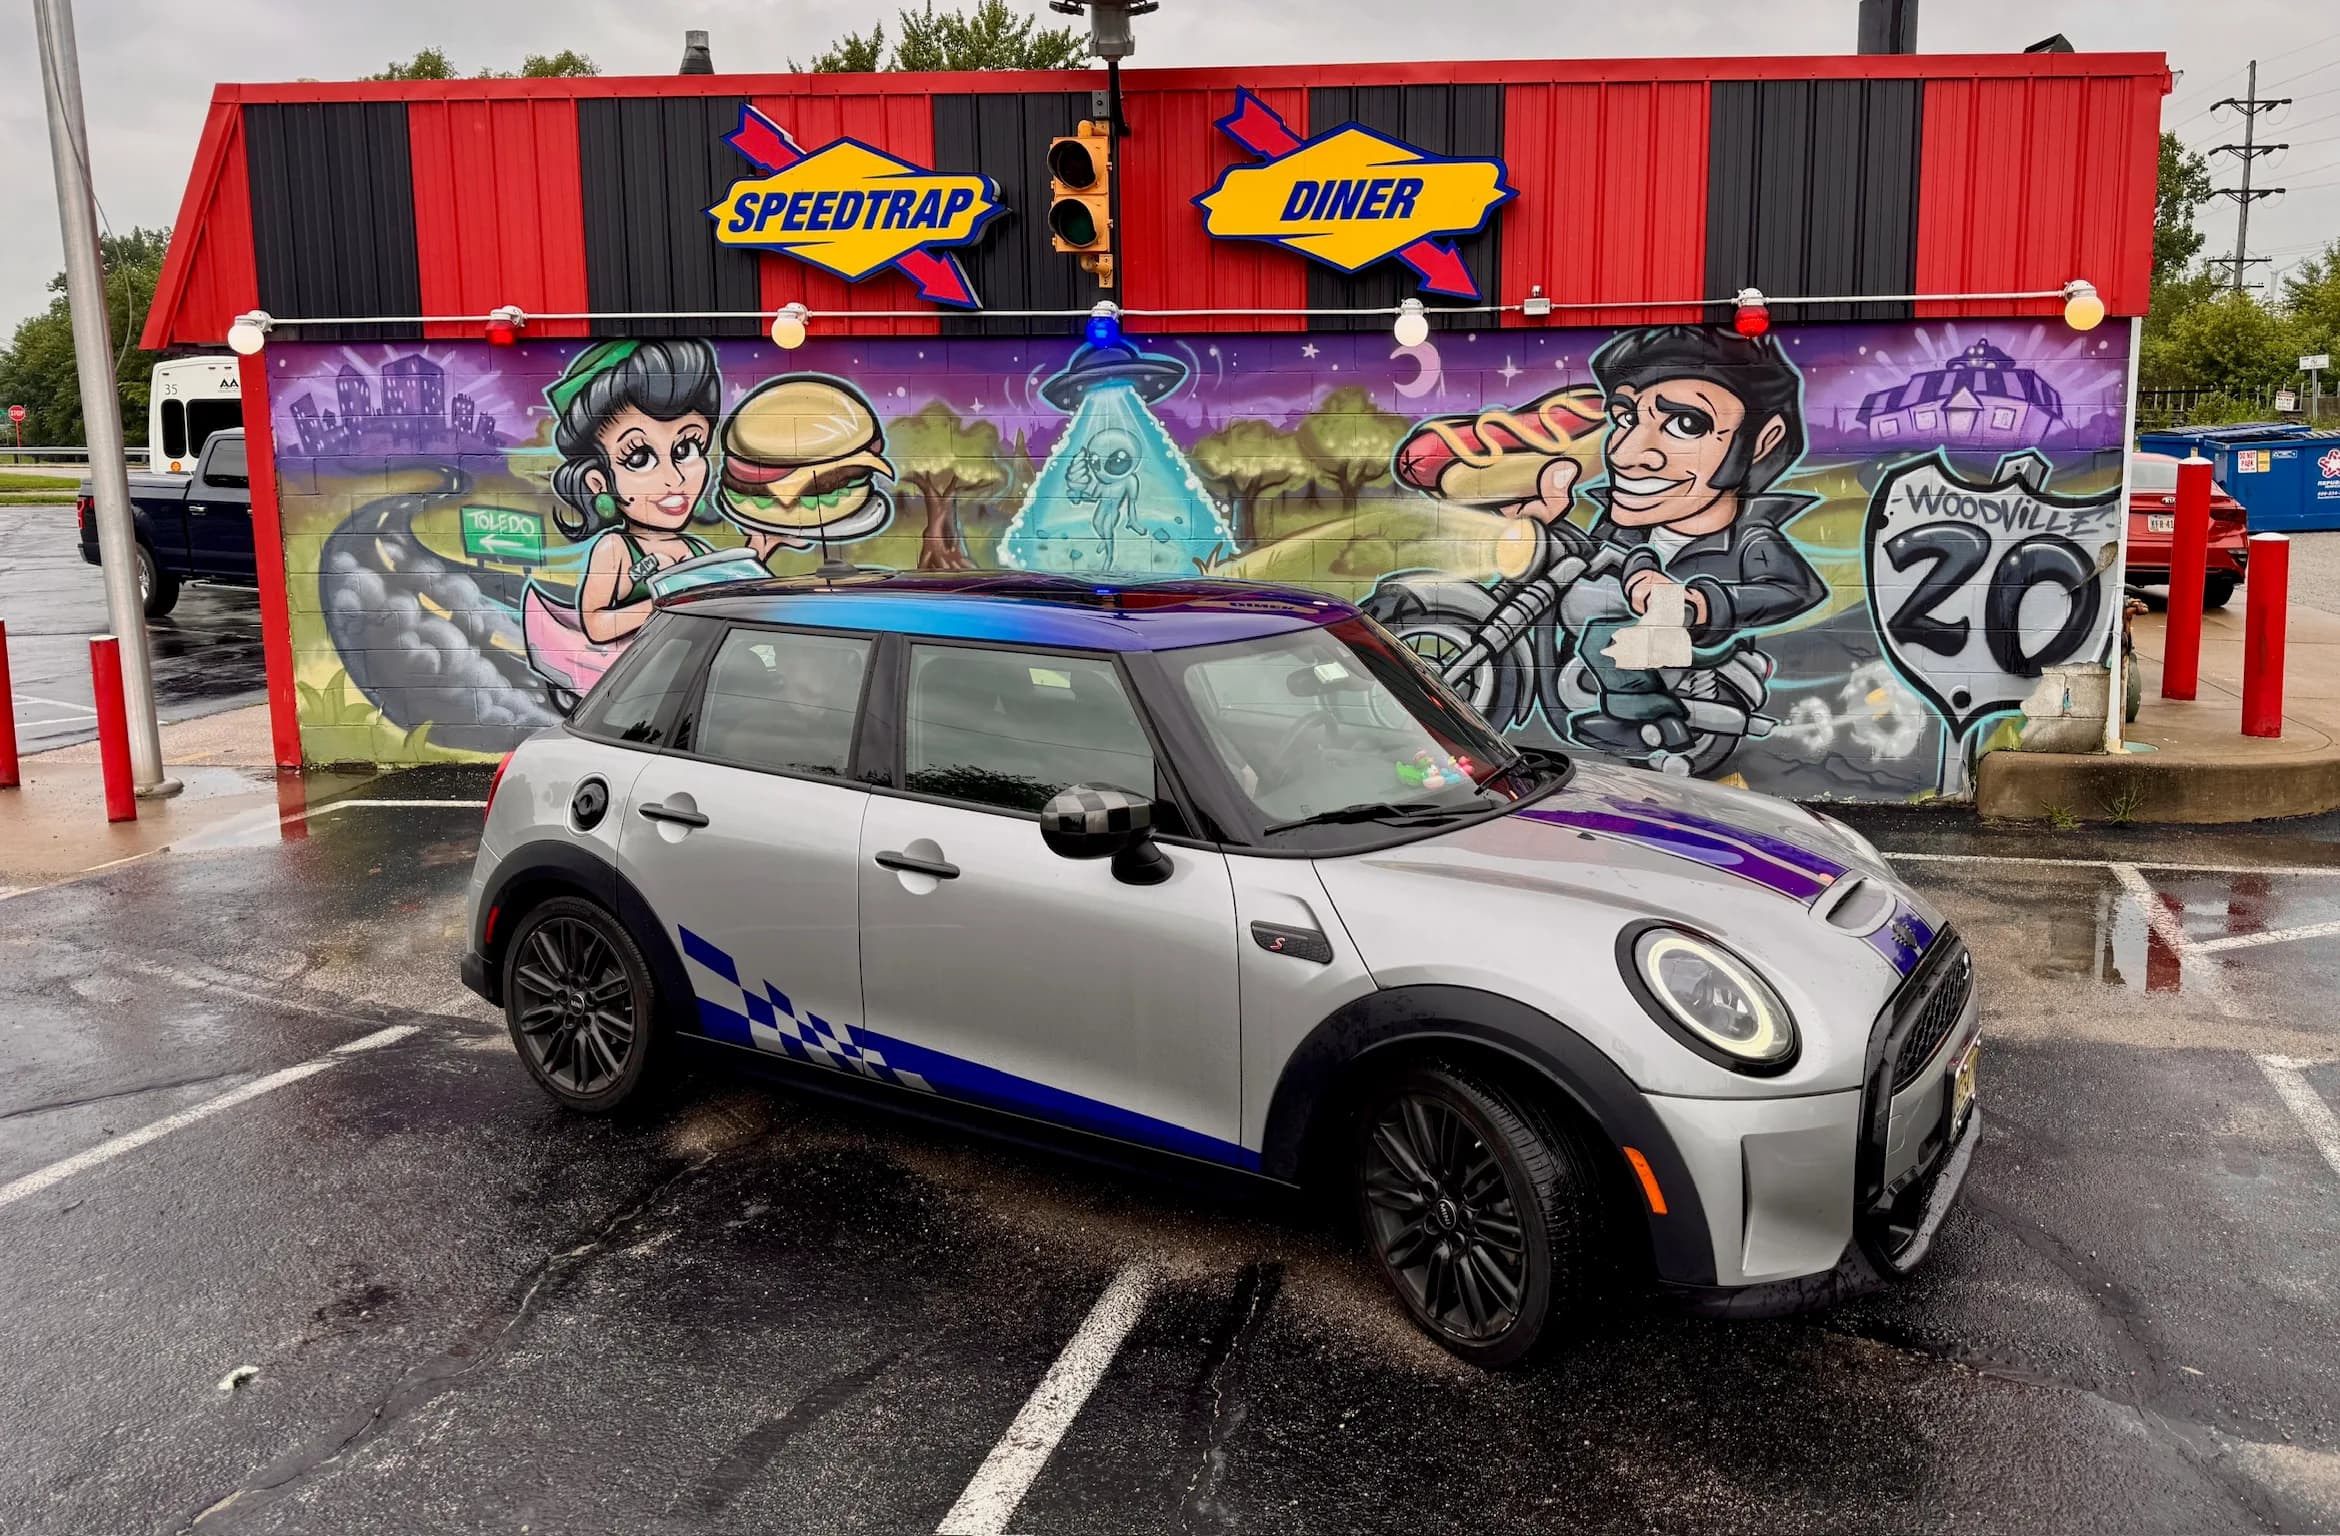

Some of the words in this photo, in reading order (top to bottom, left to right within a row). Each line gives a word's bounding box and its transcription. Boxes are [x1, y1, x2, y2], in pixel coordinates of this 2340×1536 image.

[727, 187, 975, 232] SPEEDTRAP
[1280, 177, 1425, 221] DINER
[164, 384, 178, 396] 35
[466, 510, 535, 536] TOLEDO
[1882, 520, 2101, 678] 20
[1269, 936, 1286, 951] S
[1439, 1202, 1452, 1226] MINI
